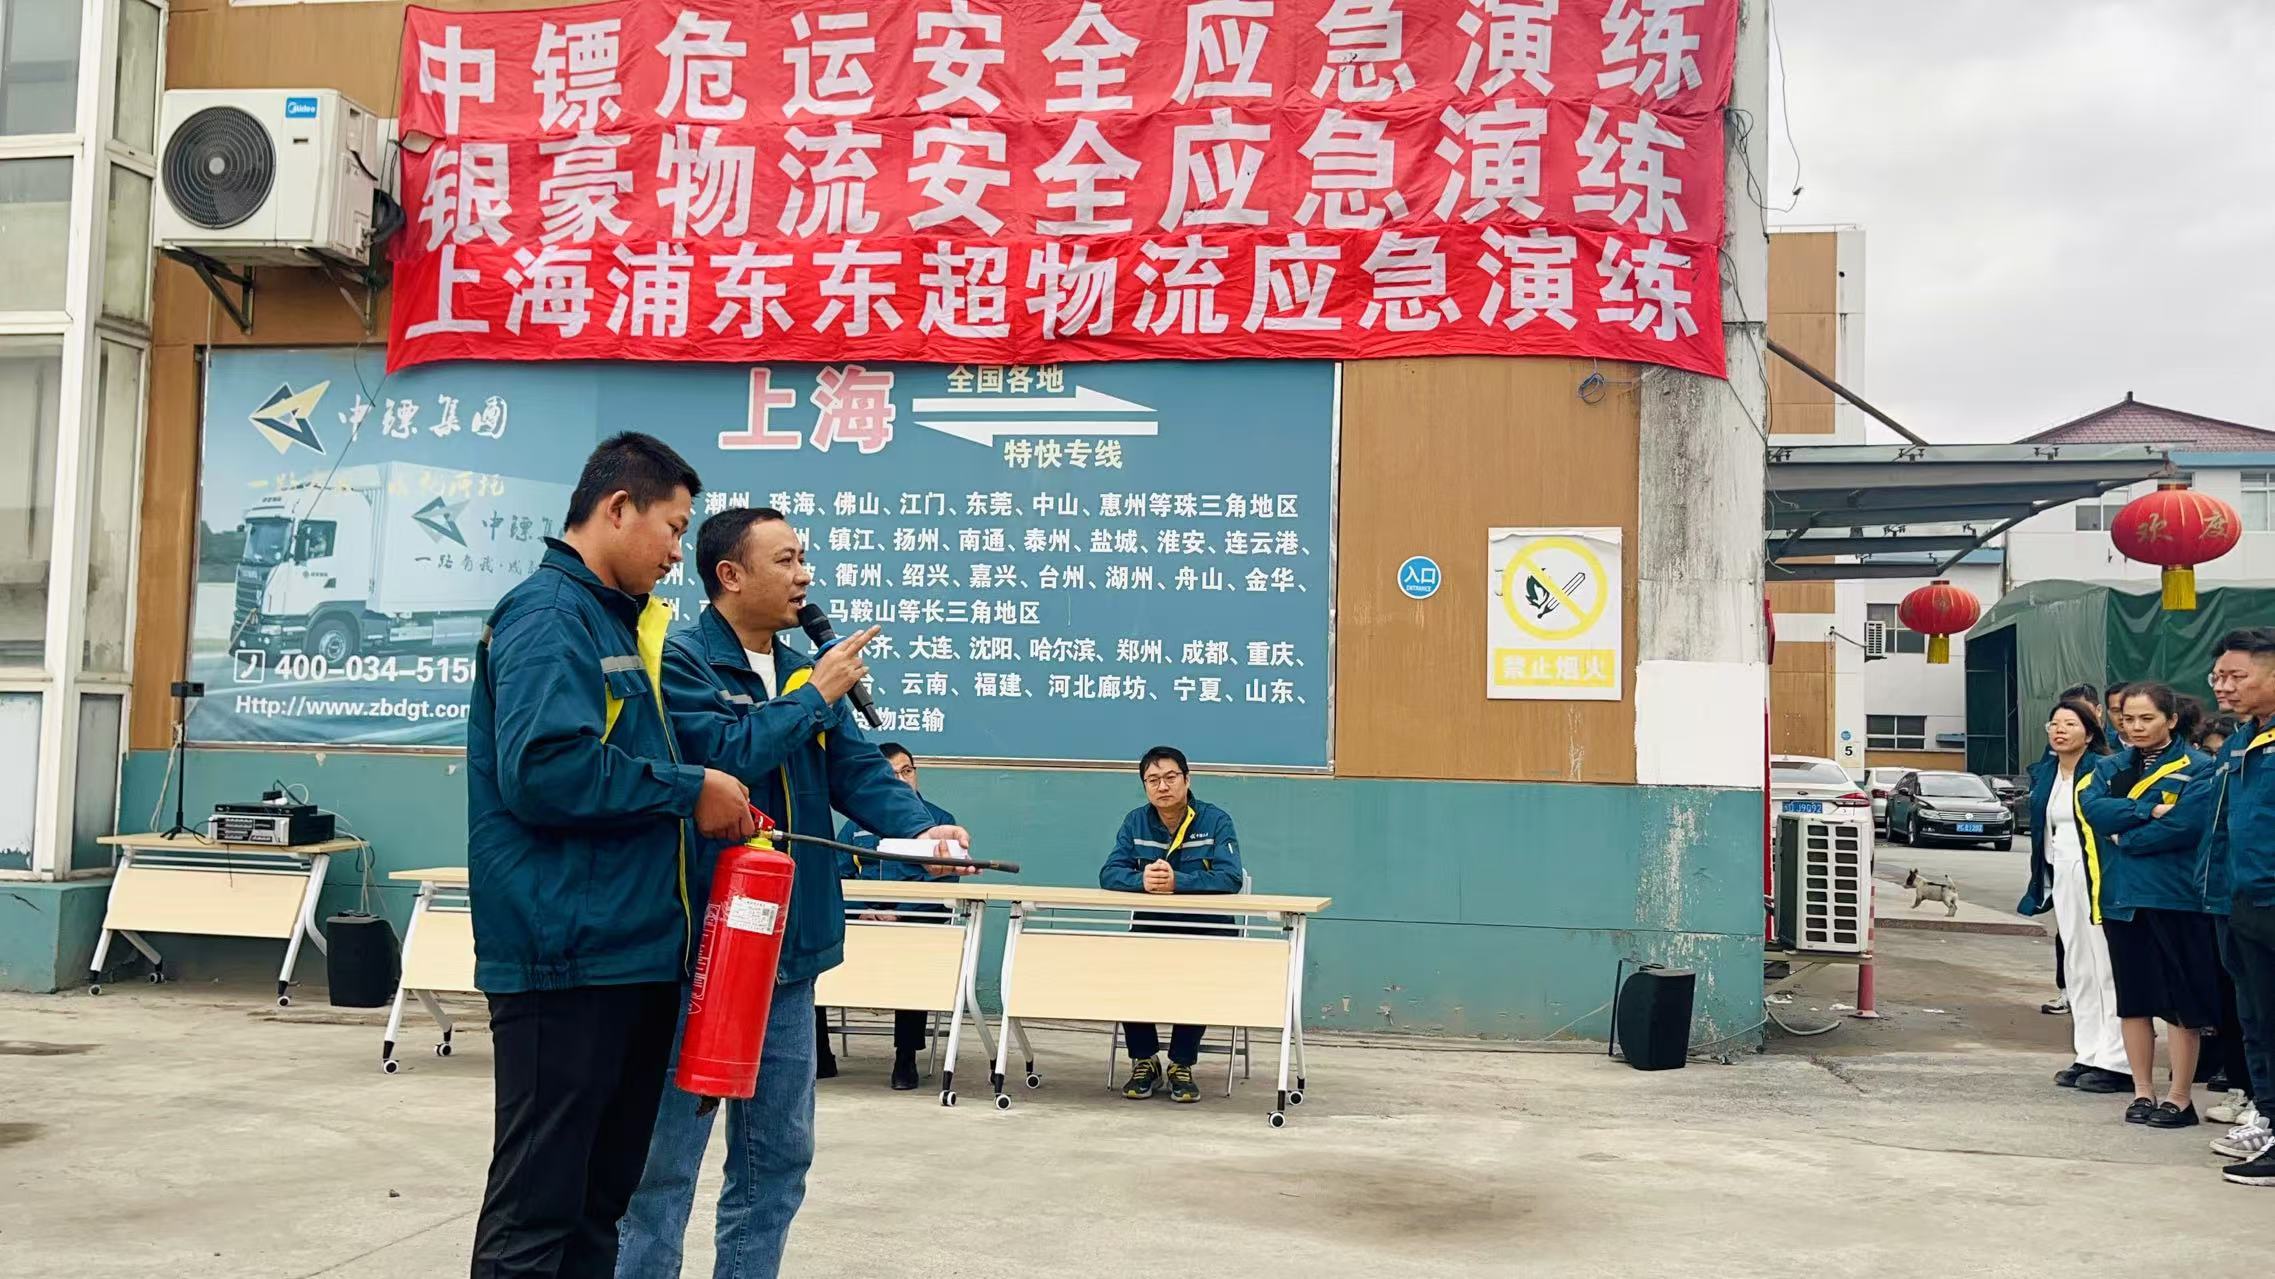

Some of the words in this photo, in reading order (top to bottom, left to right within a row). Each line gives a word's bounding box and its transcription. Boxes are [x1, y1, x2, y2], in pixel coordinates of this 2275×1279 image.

[418, 0, 1704, 135] 中镖危运安全应急演练
[418, 100, 1686, 250] 银豪物流安全应急演练
[405, 228, 1699, 341] 上海浦东东超物流应急演练
[946, 364, 1065, 394] 全国各地
[718, 365, 896, 454] 上海
[1003, 439, 1123, 469] 特快专线
[1404, 566, 1436, 584] 入口
[827, 598, 1041, 626] 马鞍山等长三角地区
[274, 655, 477, 683] 400-034-515
[1503, 655, 1606, 680] 禁止烟火
[1844, 745, 1853, 756] 5
